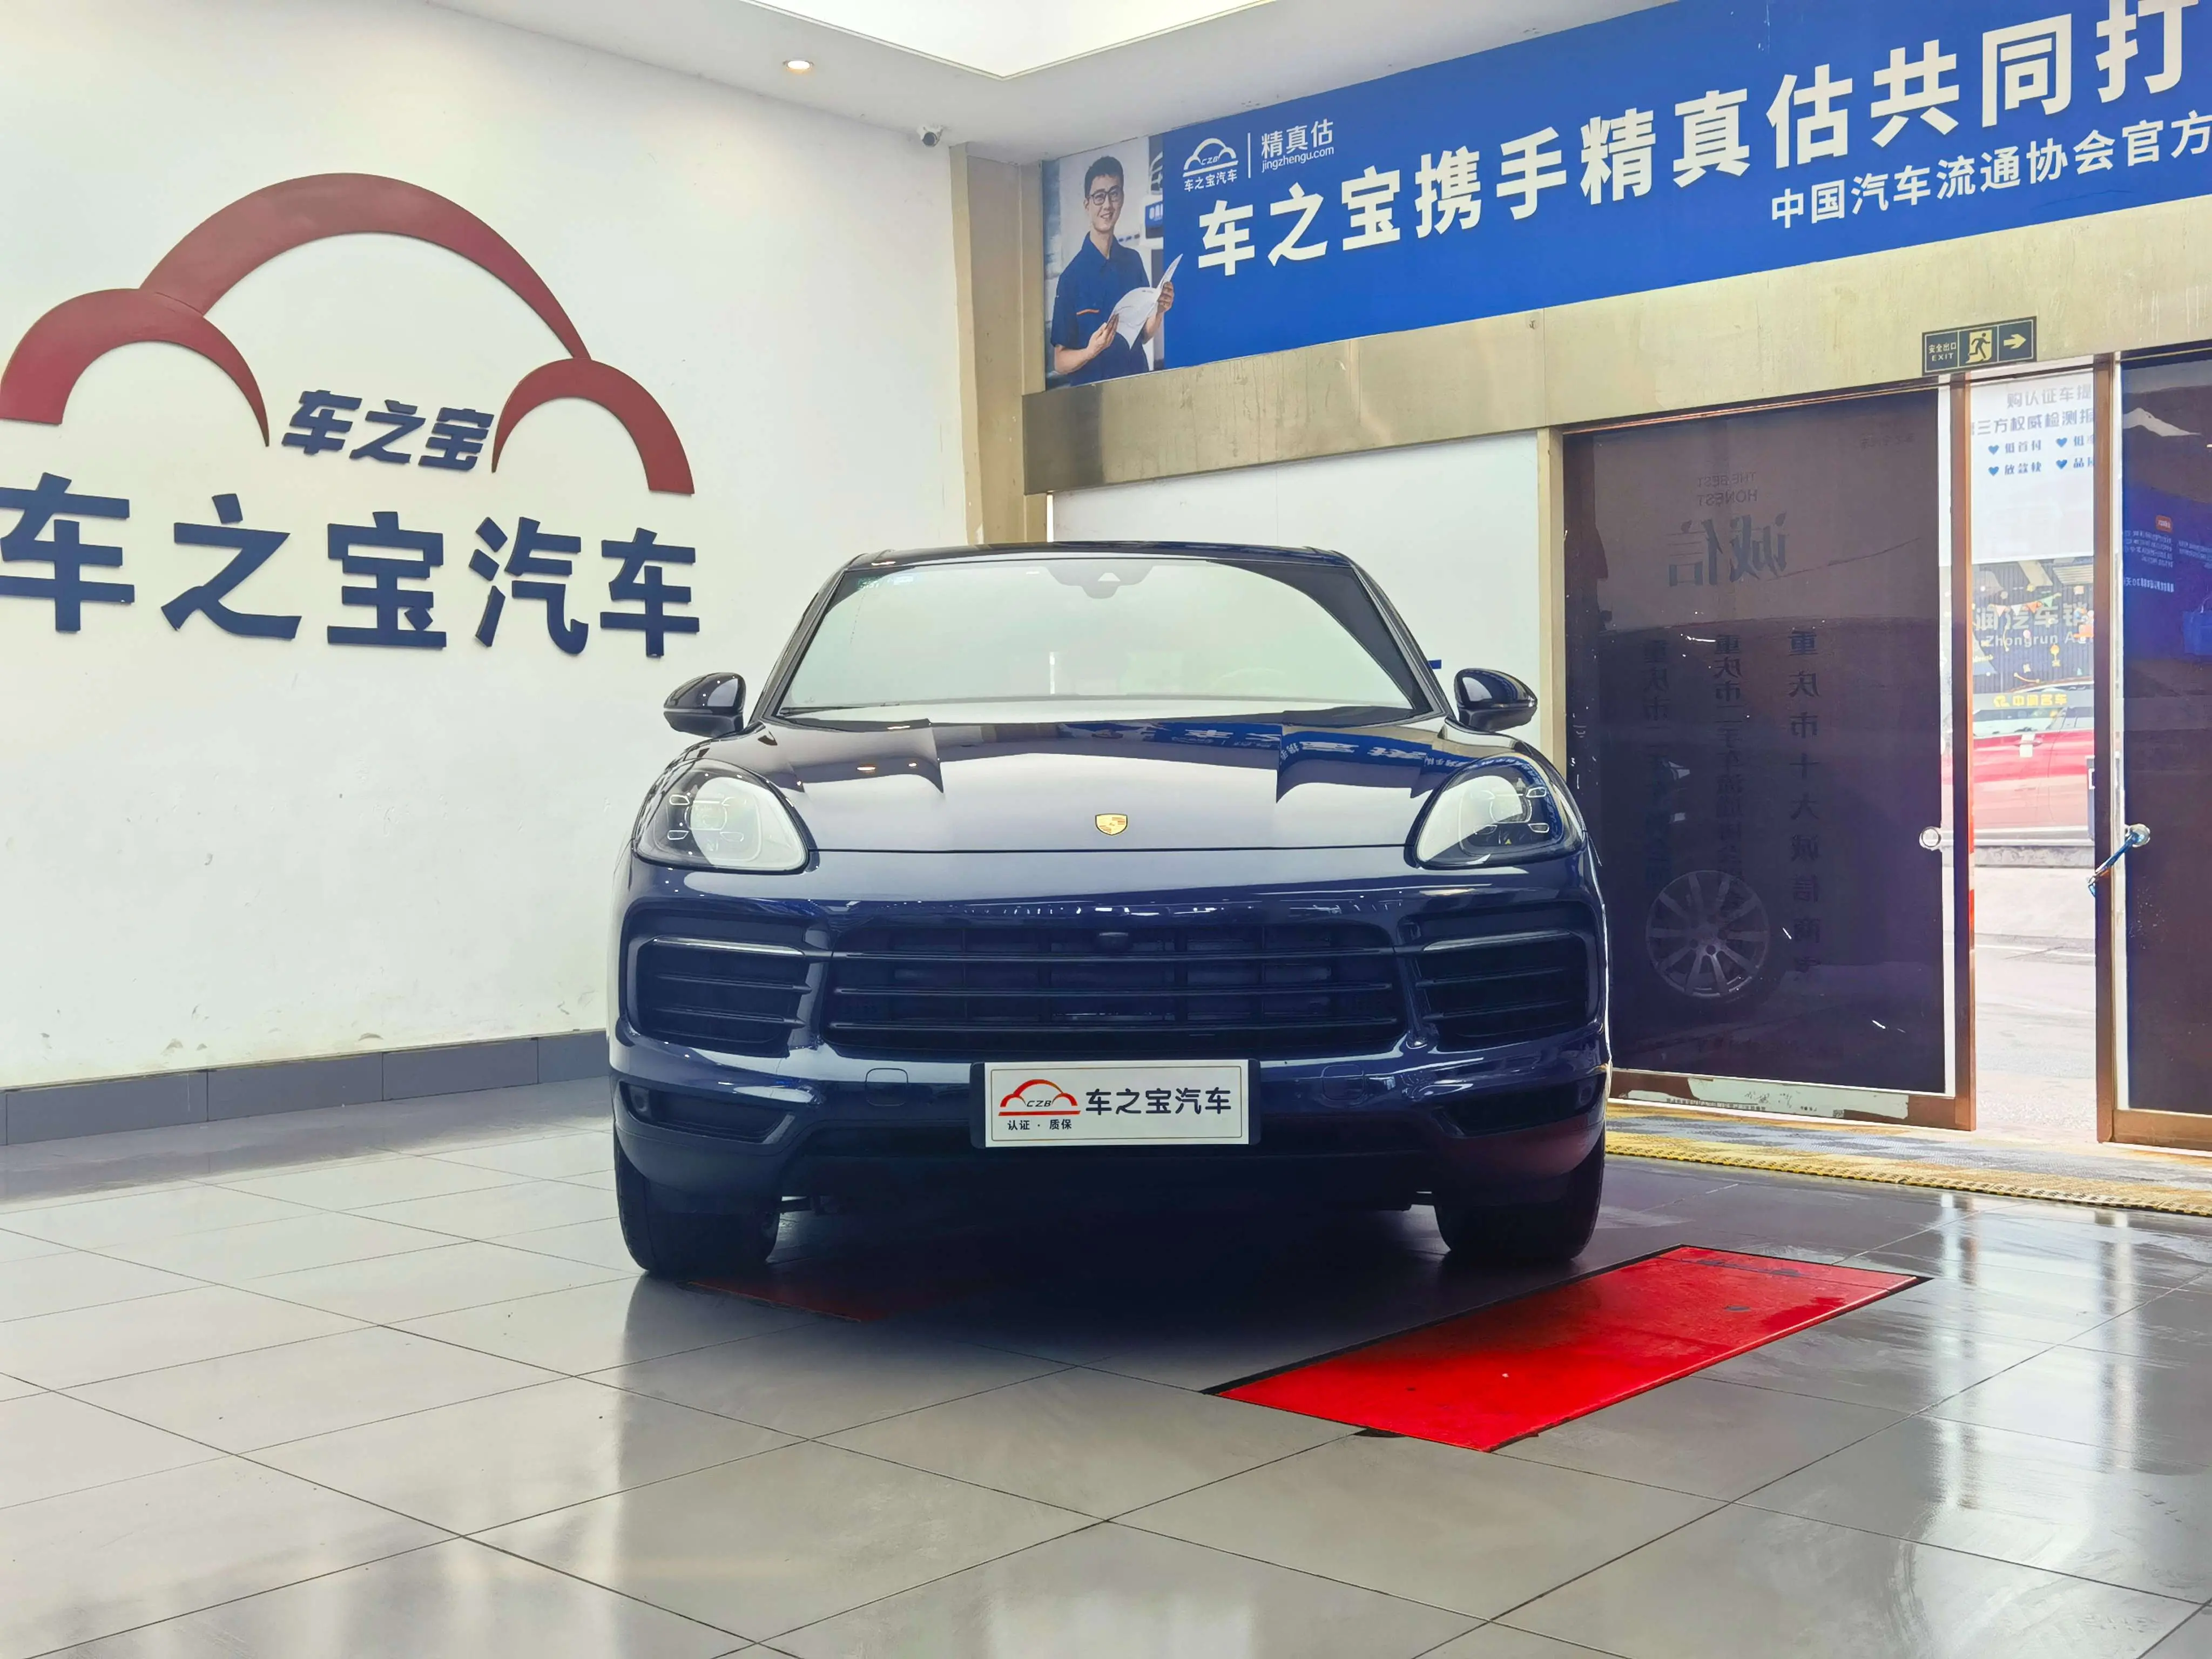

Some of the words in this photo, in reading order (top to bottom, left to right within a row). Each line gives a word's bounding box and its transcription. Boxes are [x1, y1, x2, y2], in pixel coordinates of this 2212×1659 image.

[1198, 0, 2200, 276] 车之宝携手精真估共同打
[1261, 118, 1334, 159] 精真估
[1200, 156, 1219, 166] CZB
[1262, 146, 1334, 173] jingzhengu.com
[1771, 109, 2212, 229] 中国汽车流通协会官方
[1184, 168, 1238, 192] 车之宝汽车
[1928, 342, 1957, 354] 安全出口
[1931, 352, 1954, 361] EXIT
[281, 389, 494, 471] 车之宝
[1971, 407, 2094, 436] 三方权威检测报
[0, 471, 700, 659] 车之宝汽车
[1085, 1087, 1232, 1116] 车之宝汽车
